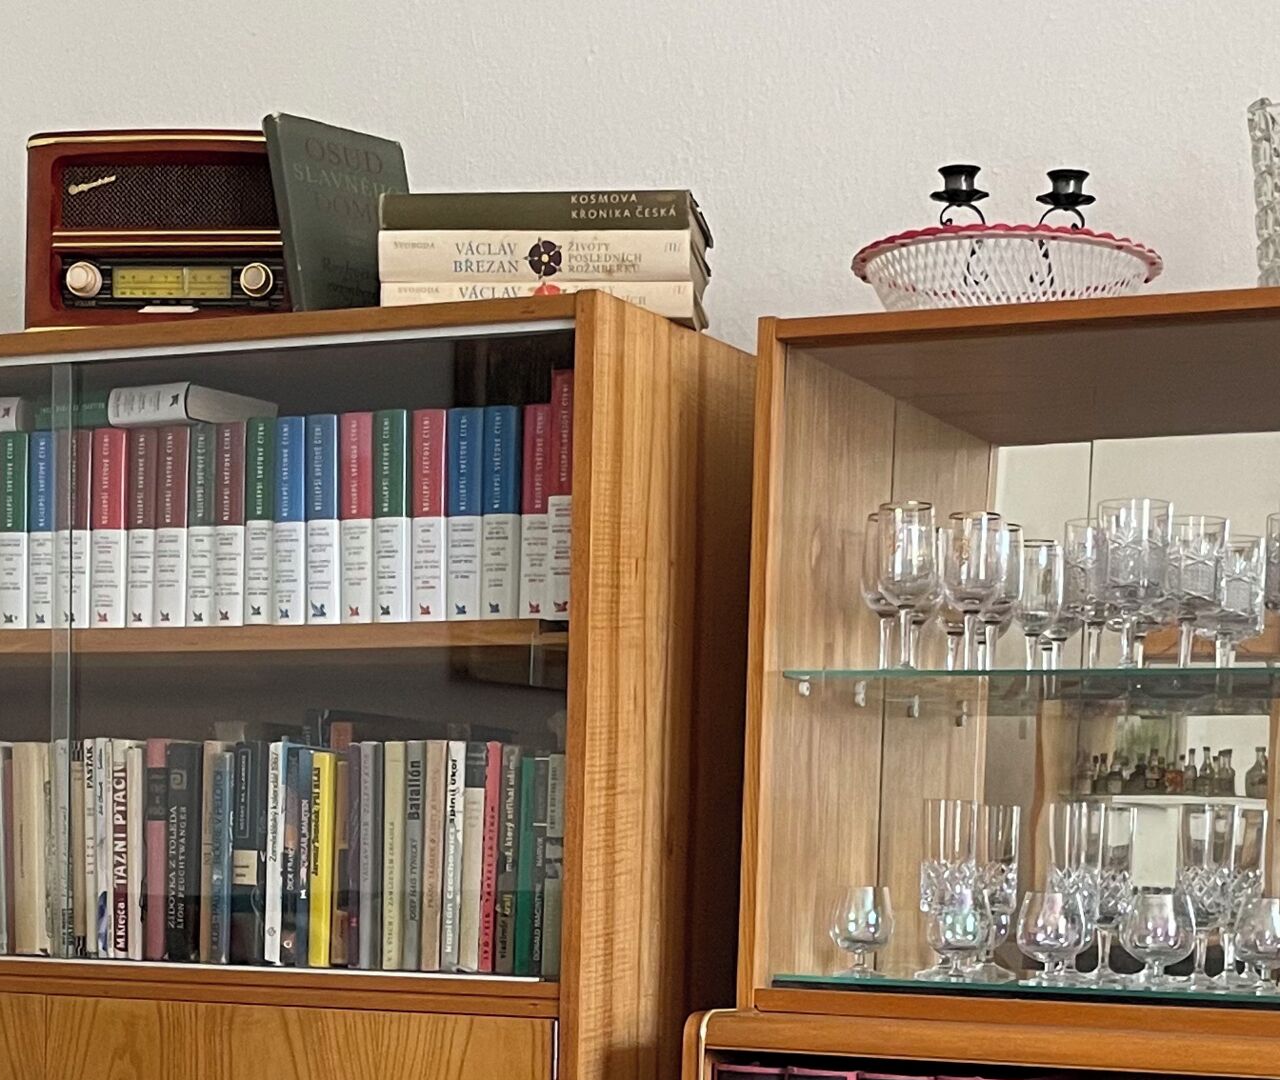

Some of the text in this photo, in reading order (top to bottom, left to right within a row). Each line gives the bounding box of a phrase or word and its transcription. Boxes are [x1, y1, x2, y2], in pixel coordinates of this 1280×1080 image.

[570, 193, 638, 204] KOSMOVA
[570, 204, 677, 219] KRONIKA ČESKÁ
[454, 239, 518, 256] VÁCLAV
[452, 256, 520, 273] BŘEZAN
[407, 759, 422, 821] Batalión
[169, 806, 178, 855] TOLEDA
[177, 806, 186, 929] LION FEUCHTWANGER
